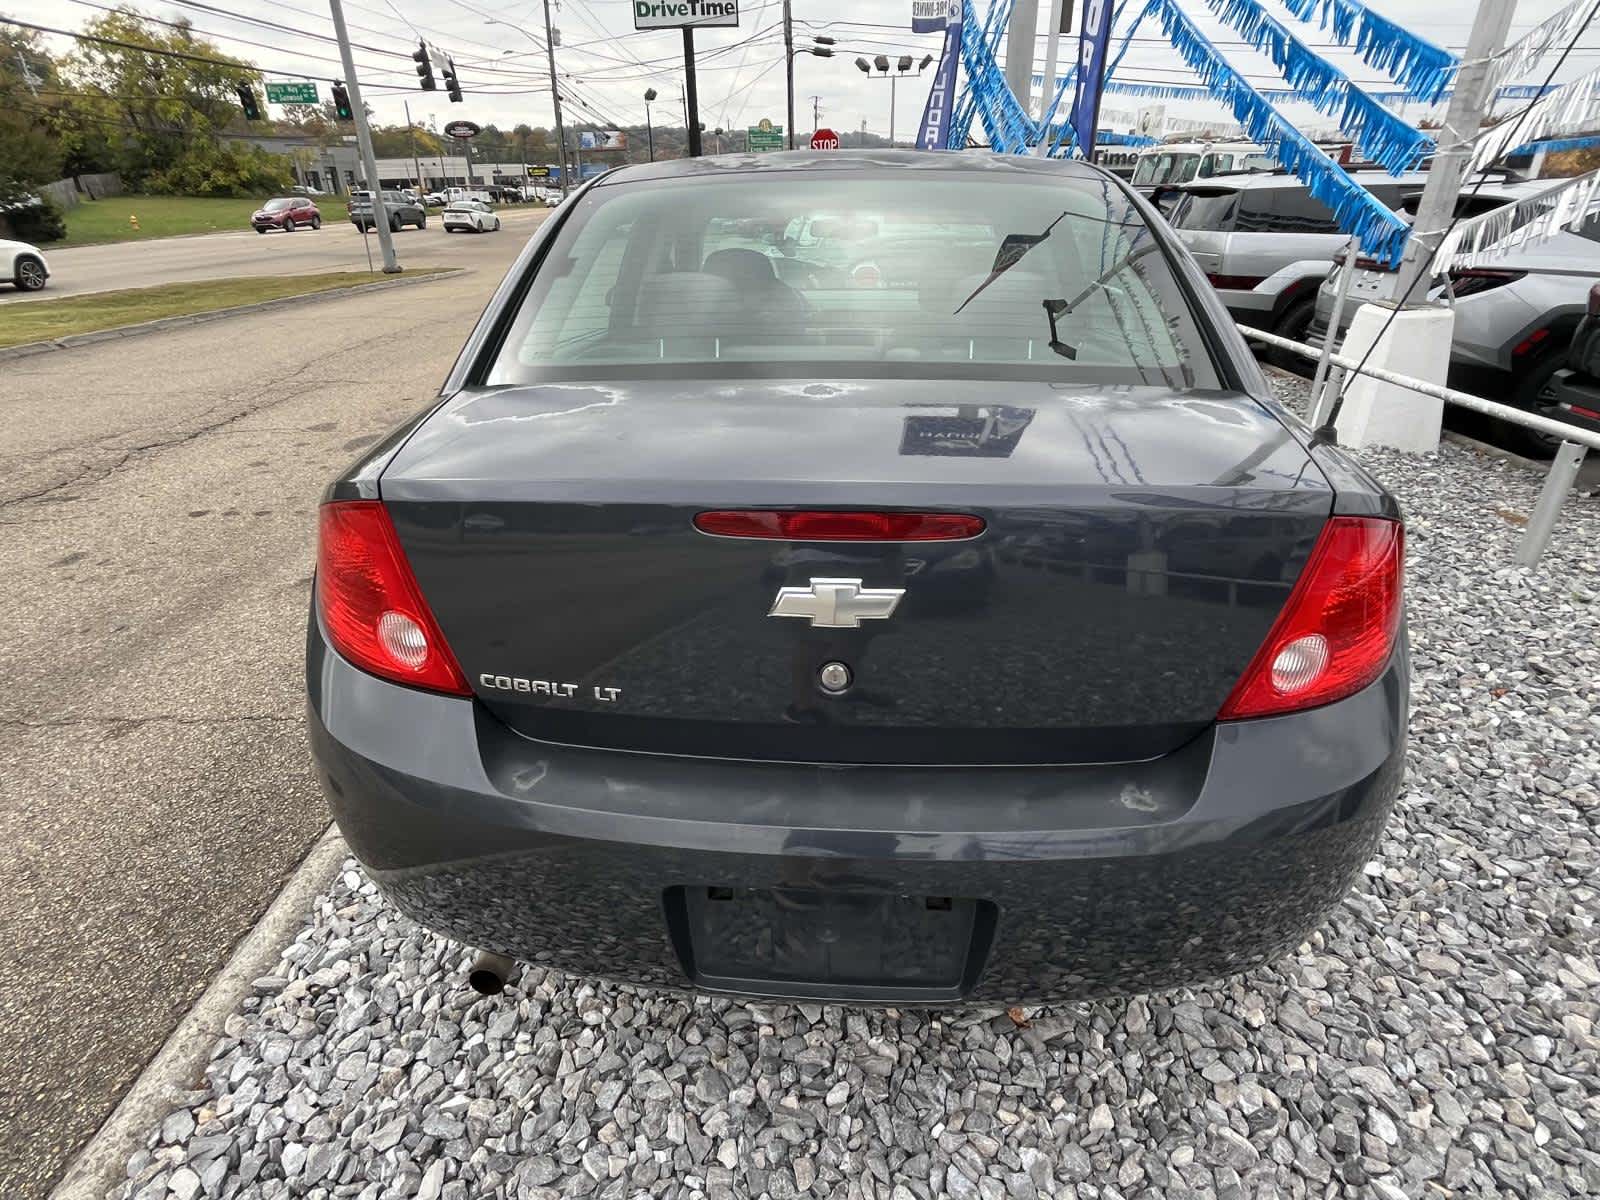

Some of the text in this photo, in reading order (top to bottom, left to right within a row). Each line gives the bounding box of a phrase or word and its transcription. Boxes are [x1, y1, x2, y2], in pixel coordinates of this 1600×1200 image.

[636, 0, 736, 17] DriveTime
[812, 139, 838, 151] STOP
[479, 673, 622, 702] COBALT LT
